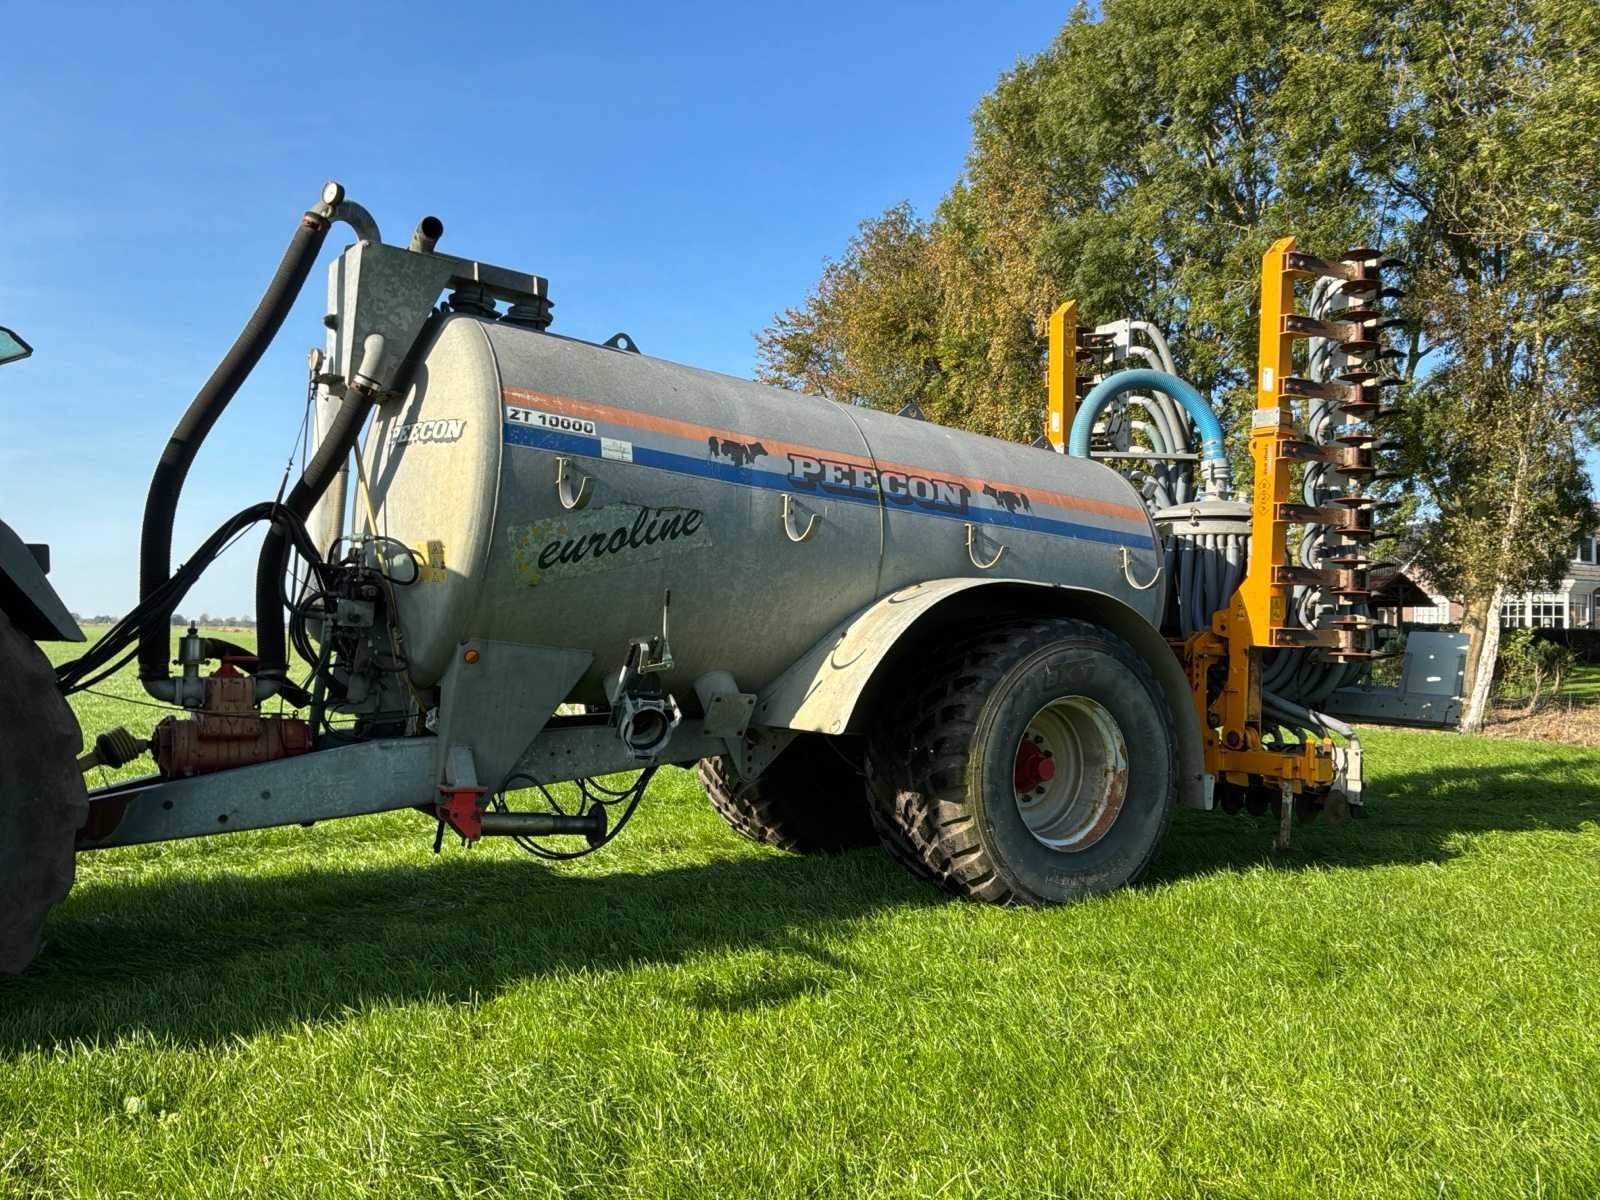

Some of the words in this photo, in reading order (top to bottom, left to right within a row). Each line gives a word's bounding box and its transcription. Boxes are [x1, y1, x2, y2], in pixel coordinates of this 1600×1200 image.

[538, 414, 595, 434] 10000
[787, 453, 970, 514] PEECON
[538, 506, 703, 569] euroline
